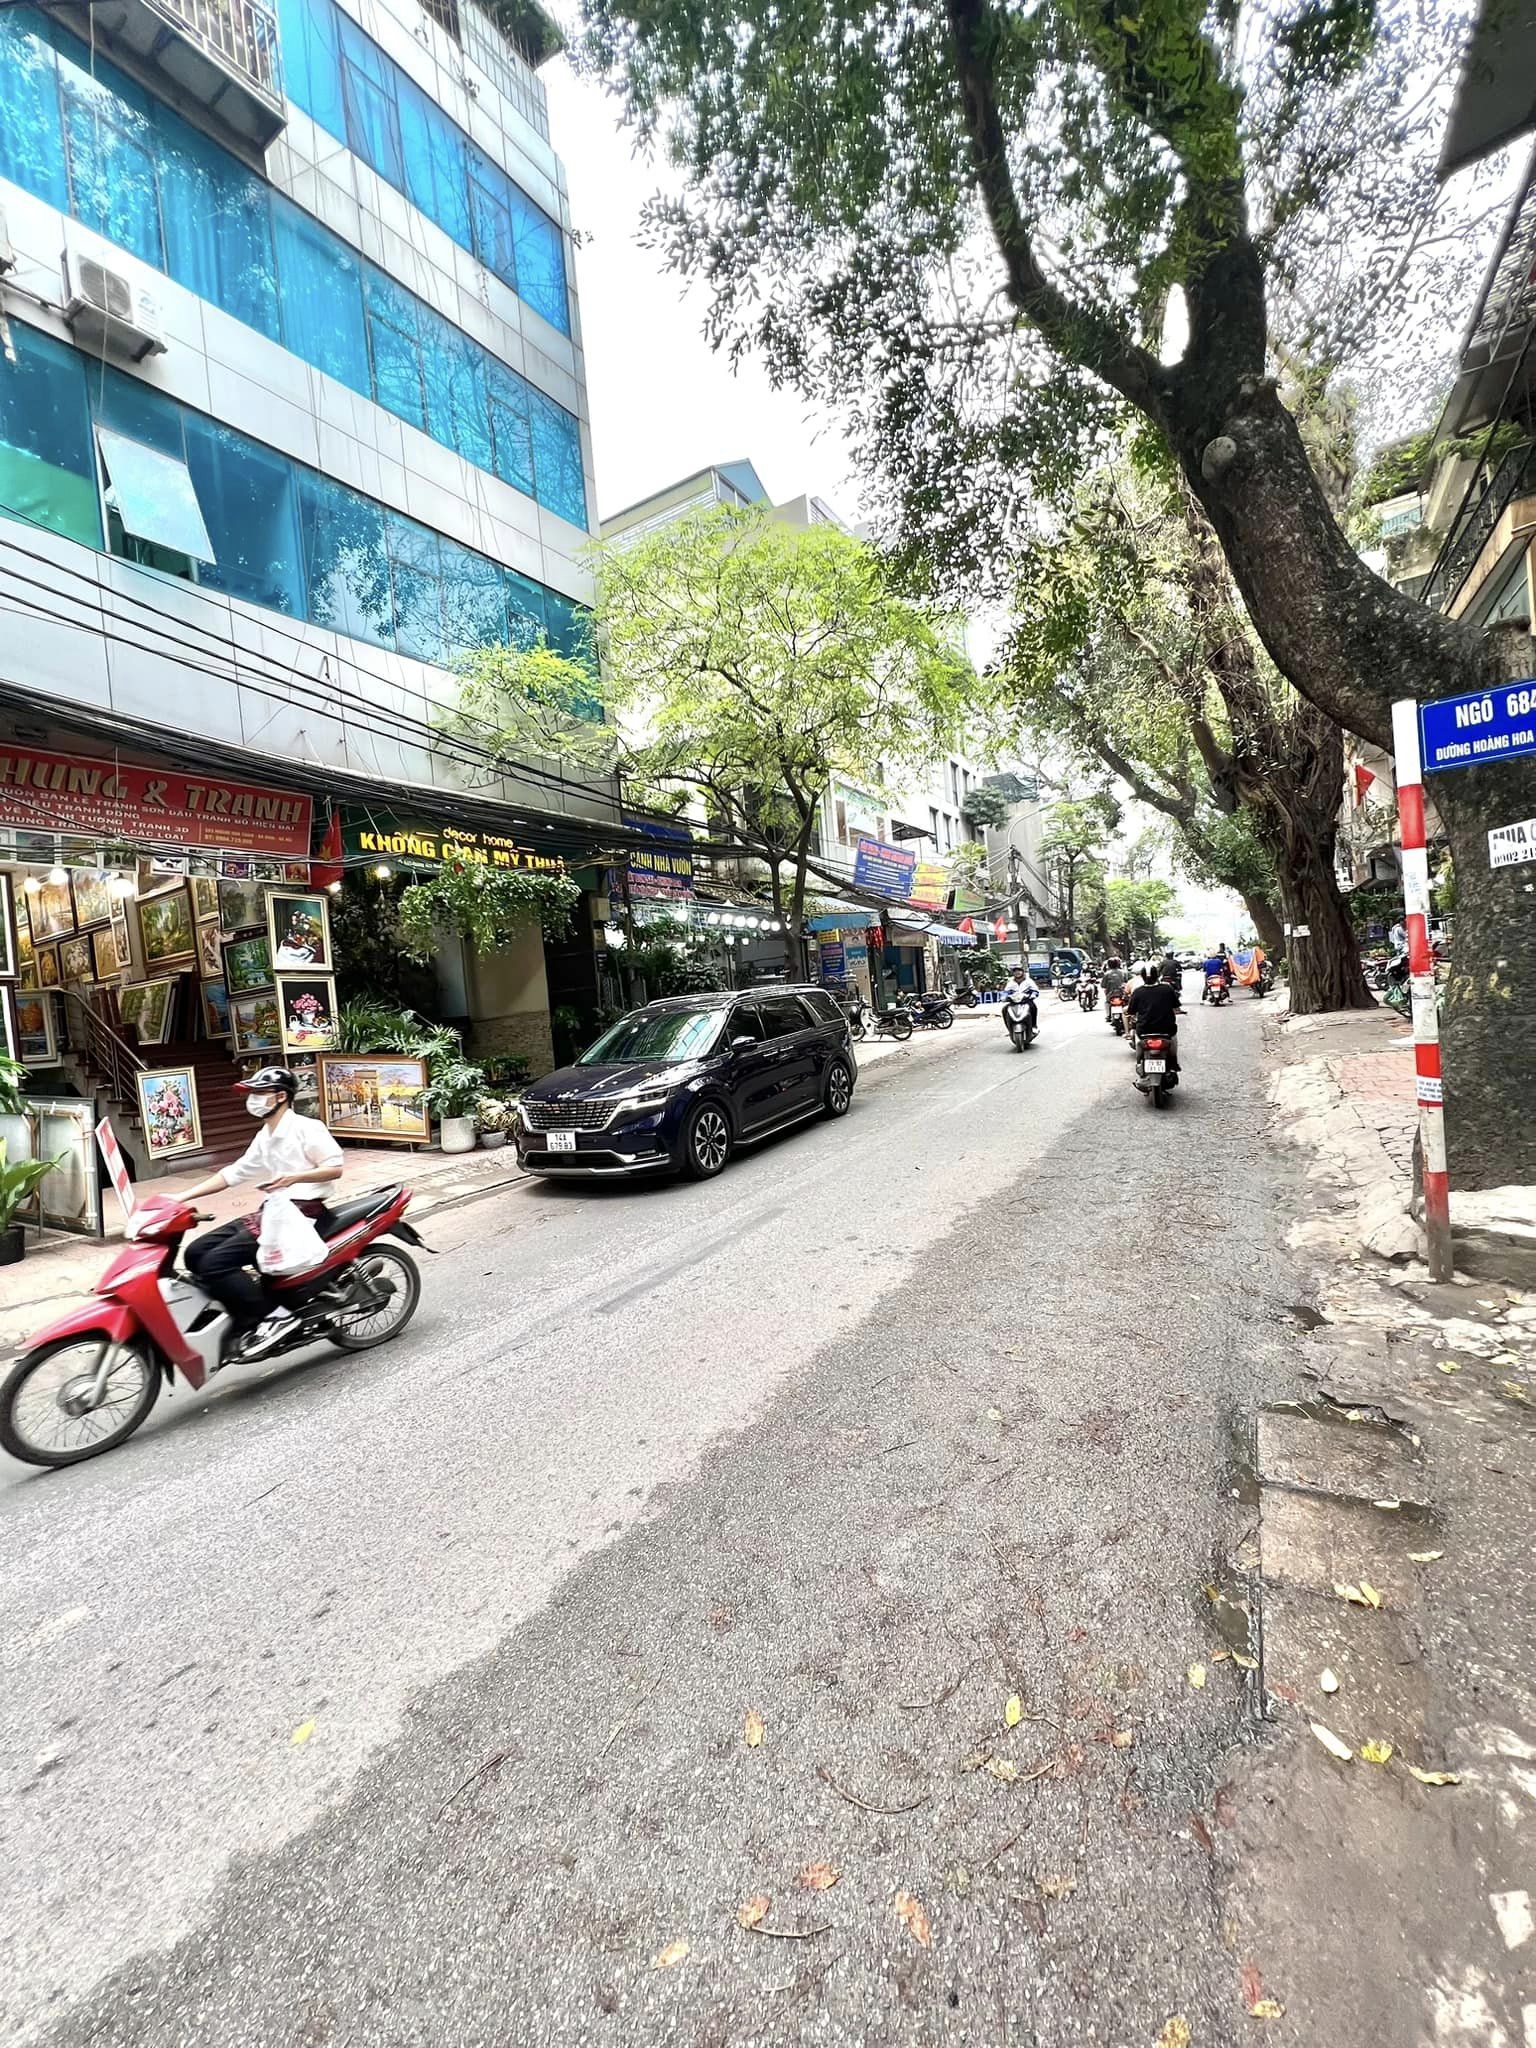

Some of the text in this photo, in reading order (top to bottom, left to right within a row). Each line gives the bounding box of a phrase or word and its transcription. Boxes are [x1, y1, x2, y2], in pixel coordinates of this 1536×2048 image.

[1455, 694, 1494, 728] NGÕ
[1472, 734, 1509, 753] HOÀNG
[1511, 729, 1534, 746] HOA
[56, 803, 101, 815] TRANH
[96, 799, 137, 811] TRANH
[142, 779, 168, 808] &
[184, 783, 303, 824] TRANH
[132, 820, 171, 832] TRANH
[174, 825, 189, 834] 3D
[443, 826, 514, 849] decor home
[360, 831, 436, 859] KHÔNG
[493, 848, 520, 868] MỸ
